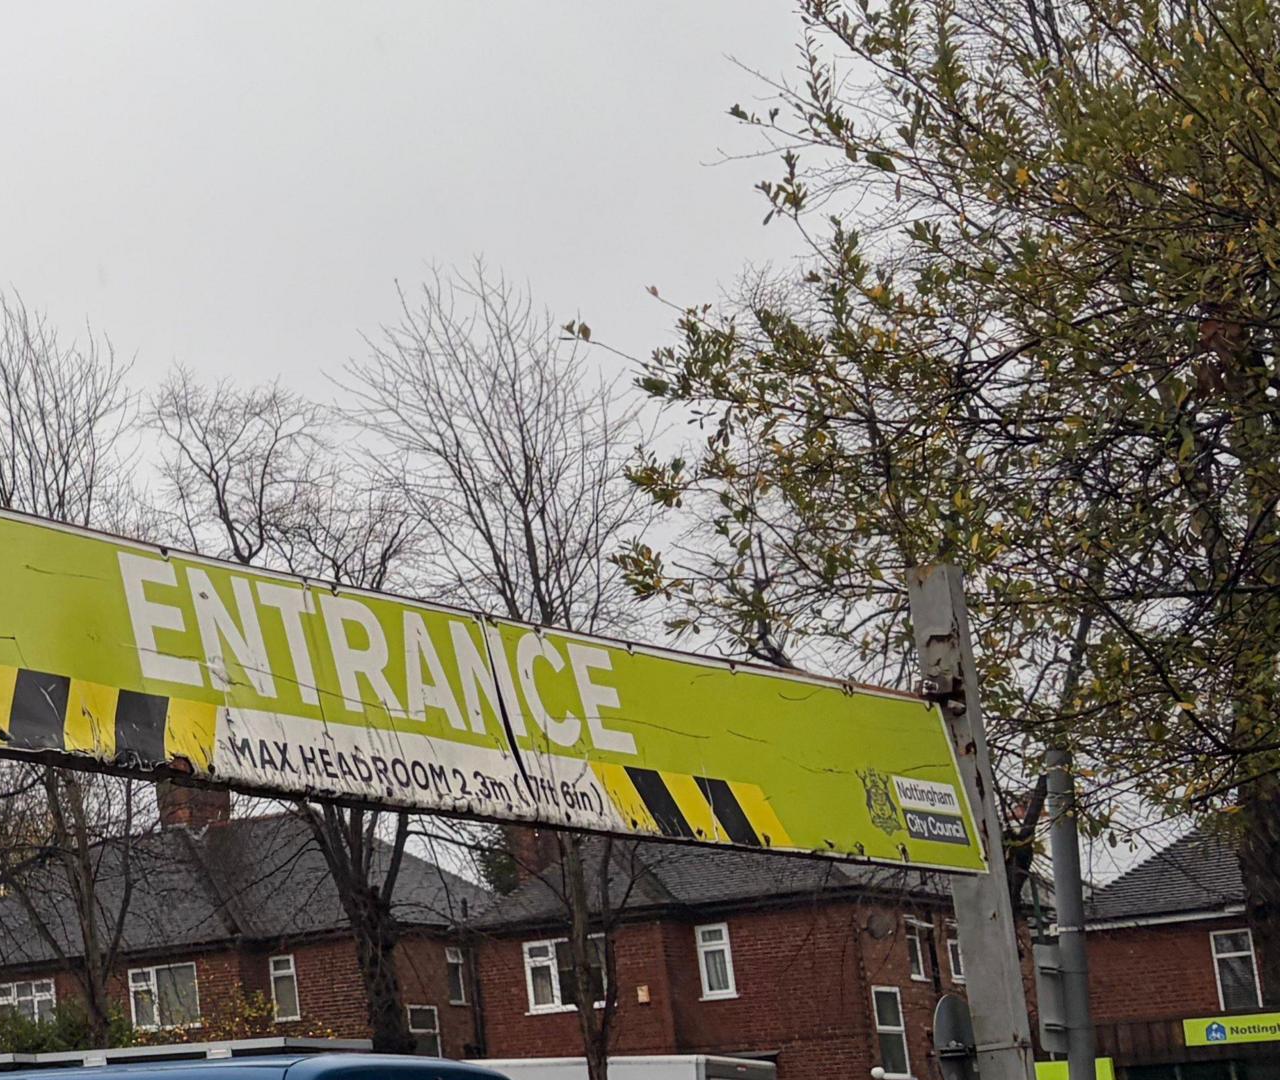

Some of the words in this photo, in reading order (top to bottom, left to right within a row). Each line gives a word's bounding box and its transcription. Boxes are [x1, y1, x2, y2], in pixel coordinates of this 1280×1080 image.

[117, 551, 637, 755] ENTRANCE
[229, 736, 297, 775] MAX
[300, 744, 450, 793] HEADROOM
[452, 768, 510, 801] 2.3m
[560, 780, 603, 816] 6in)
[896, 781, 955, 807] Nottingham
[906, 813, 929, 837] City
[928, 816, 966, 839] Council
